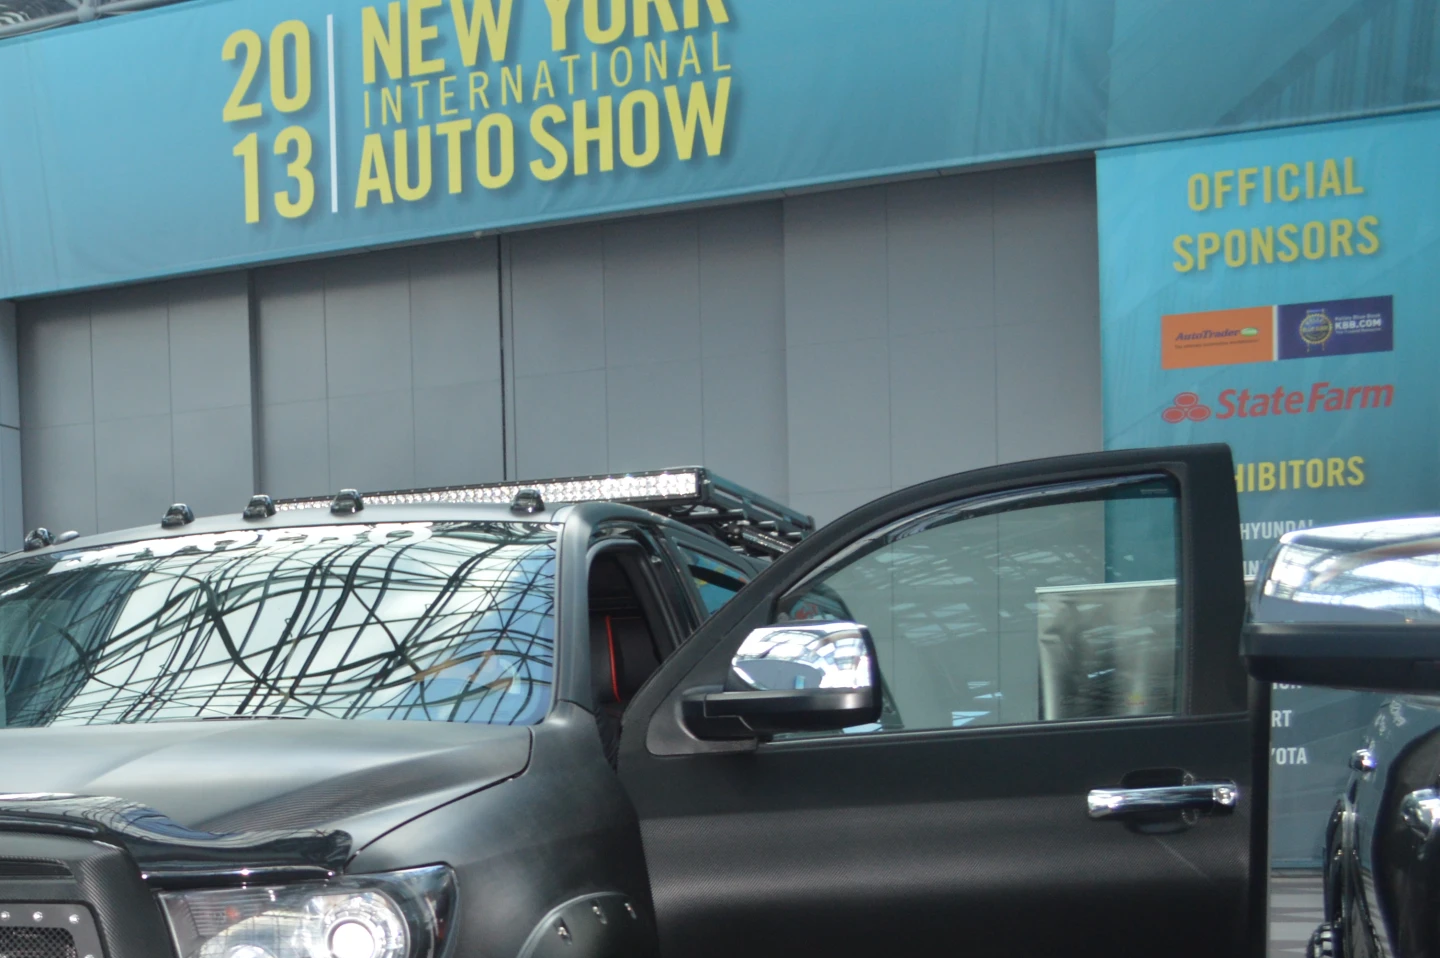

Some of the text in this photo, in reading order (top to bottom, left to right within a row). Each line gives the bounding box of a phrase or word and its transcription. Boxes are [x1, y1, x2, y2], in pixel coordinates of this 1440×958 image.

[221, 19, 311, 122] 20
[362, 0, 513, 84] NEW
[363, 30, 732, 129] INTERNATIONAL
[232, 125, 315, 223] 13
[354, 76, 732, 208] AUTO SHOW
[1187, 156, 1365, 212] OFFICIAL
[1172, 215, 1380, 273] SPONSORS
[1335, 319, 1382, 330] KBB.COM
[1235, 455, 1365, 493] HIBITORS
